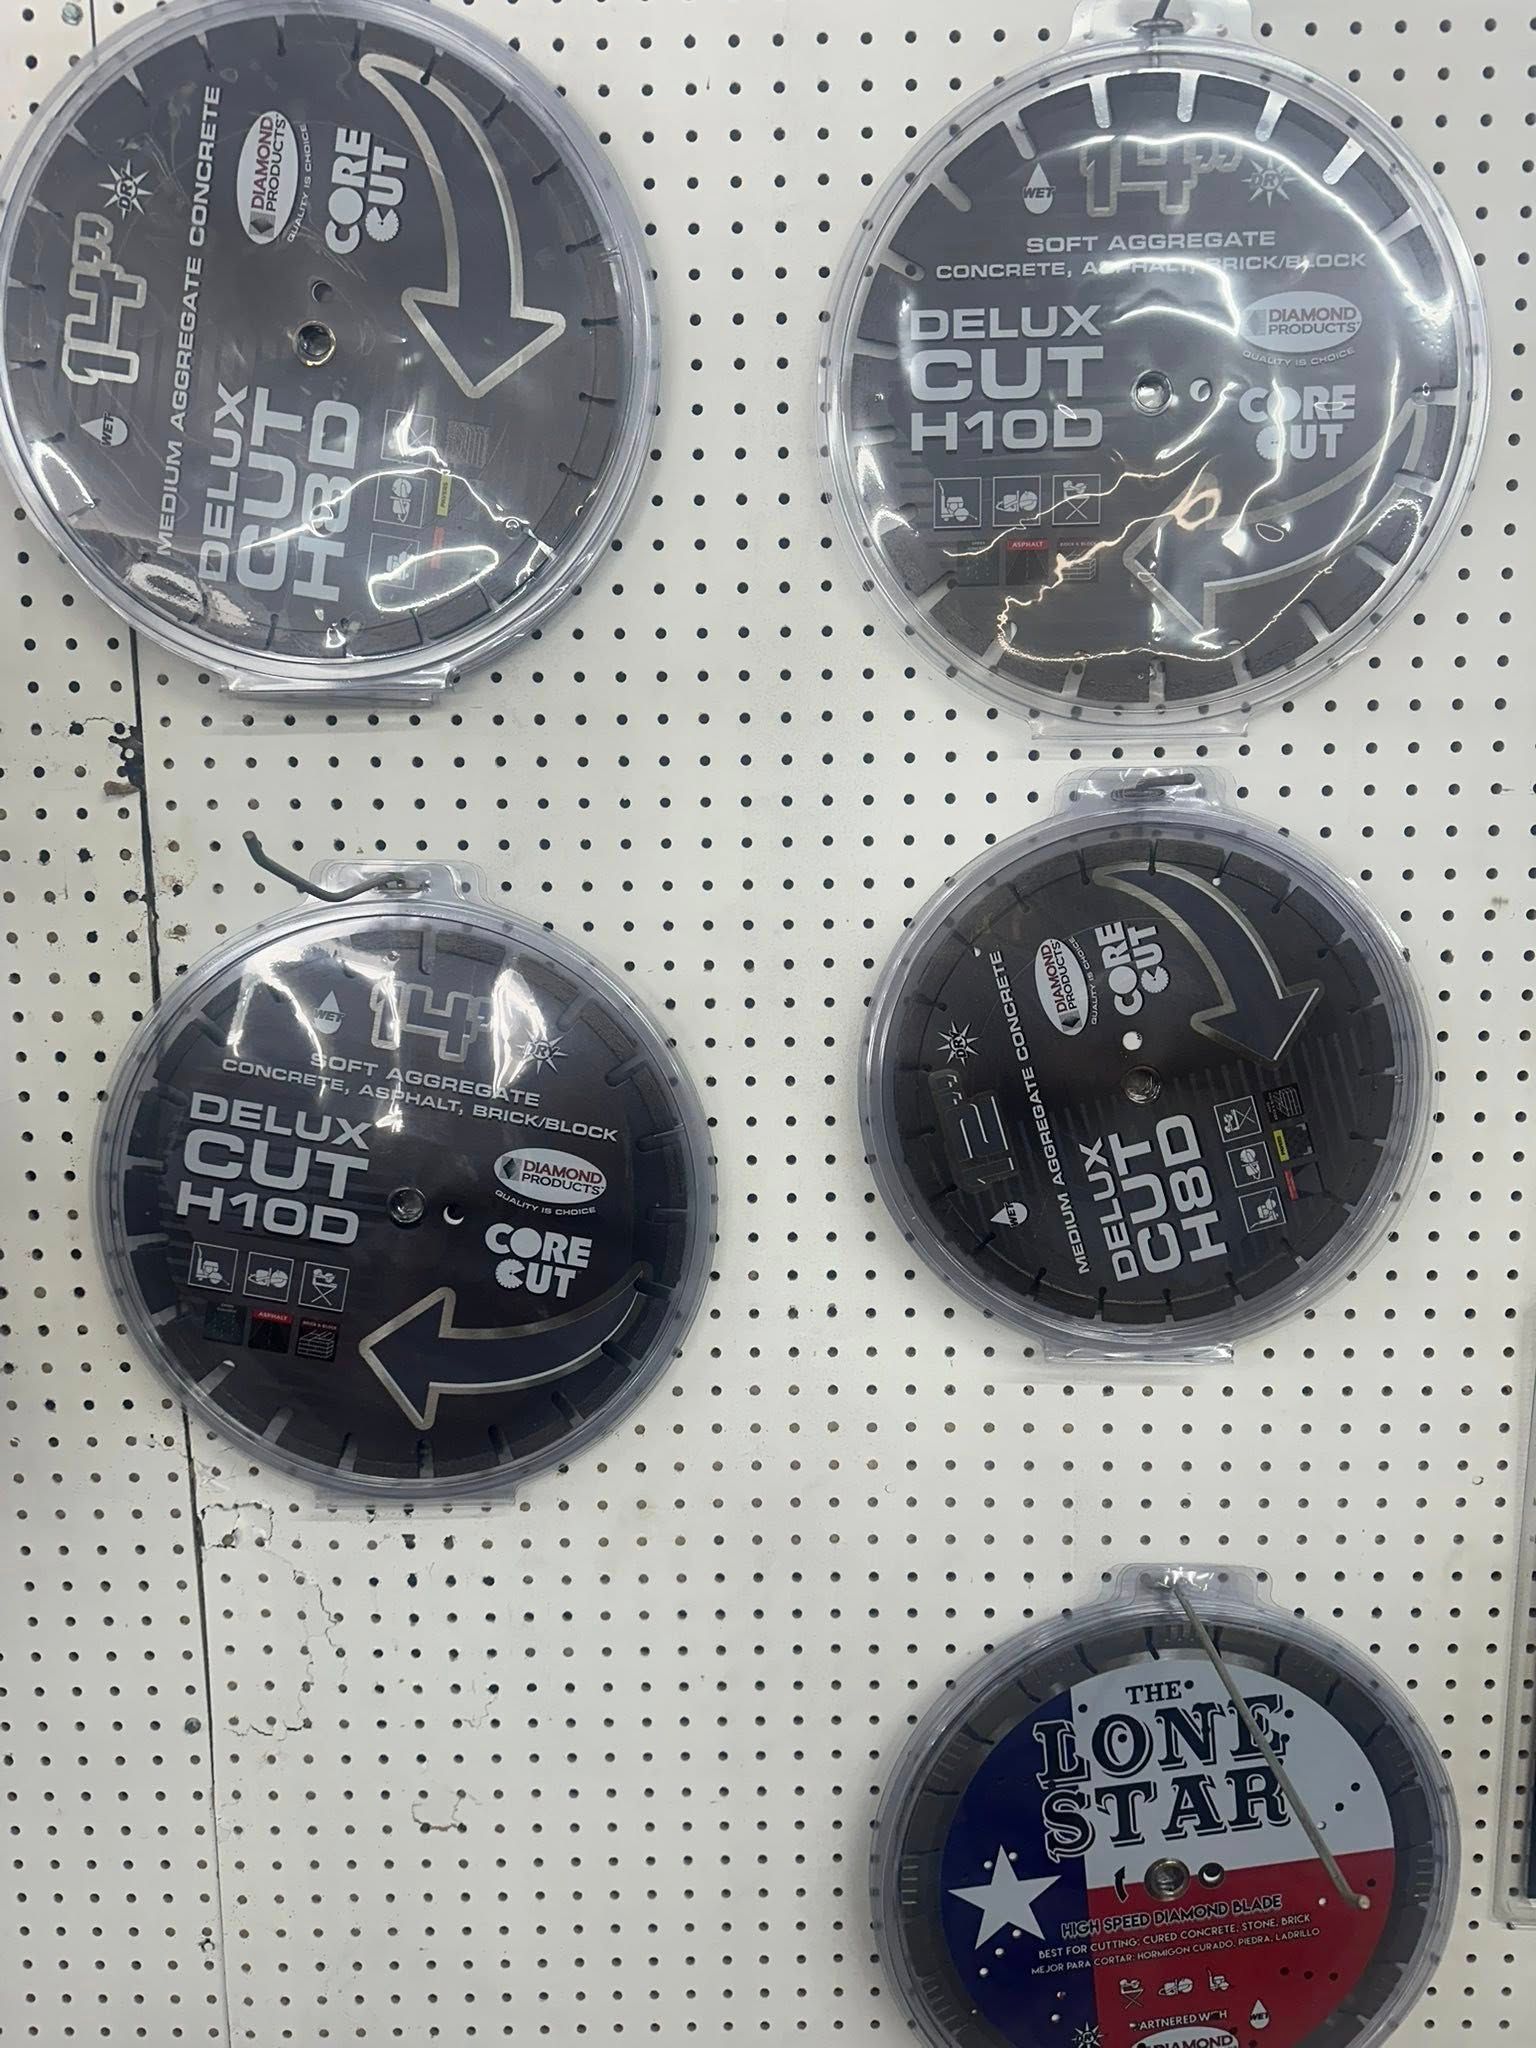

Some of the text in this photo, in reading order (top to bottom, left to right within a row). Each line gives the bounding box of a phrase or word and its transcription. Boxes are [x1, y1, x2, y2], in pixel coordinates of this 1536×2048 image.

[251, 116, 274, 210] DIAMOND
[266, 118, 287, 212] PRODUCTS
[287, 123, 312, 243] QUALITY IS CHOICE
[117, 167, 134, 211] DRY
[325, 127, 371, 254] CORE
[365, 145, 407, 242] CUT
[1023, 187, 1055, 199] WET
[1026, 231, 1276, 253] SOFT AGGREGATE
[936, 253, 1367, 279] CONCRETE, AHALT, BRICK/BLOCK
[157, 86, 220, 556] MEDIUM AGGREGATE CONCRETE
[910, 305, 1102, 341] DELUX
[1268, 307, 1357, 323] DIAMOND
[1268, 322, 1357, 335] PRODUCTS
[910, 346, 1104, 401] CUT
[1242, 347, 1355, 366] QUALITY IS CHOICE
[1239, 384, 1356, 423] CORE
[101, 413, 114, 446] WET
[911, 408, 1103, 452] H10D
[1256, 423, 1344, 460] CUT
[198, 381, 248, 582] DELUX
[236, 386, 303, 591] CUT
[292, 400, 360, 602] H8D
[1052, 941, 1078, 1010] PRODUCTS
[1068, 936, 1090, 970] CHOICE
[1094, 921, 1144, 1016] CORE
[1126, 925, 1170, 994] CUT
[1041, 944, 1068, 1013] DIAMOND
[315, 1009, 345, 1023] WET
[1090, 983, 1098, 1025] QUALITY
[951, 1031, 968, 1059] DRY
[222, 1058, 619, 1142] CONCRETE, ASPHALT, BRICK/BLOCK
[310, 1052, 541, 1107] SOFT AGGREGATE
[190, 1092, 372, 1150] DELUX
[989, 950, 1090, 1275] MEDIUM AGGREGATE CONCRETE
[184, 1128, 370, 1200] CUT
[521, 1172, 601, 1196] PRODUCTS
[523, 1160, 603, 1185] DIAMOND
[495, 1189, 539, 1212] QUALITY
[555, 1206, 597, 1216] CHOICE
[1079, 1137, 1140, 1282] DELUX
[1108, 1133, 1182, 1274] CUT
[1156, 1114, 1228, 1262] H8D
[176, 1181, 360, 1245] H10D
[1004, 1201, 1018, 1229] WET
[485, 1222, 593, 1269] CORE
[495, 1258, 577, 1299] CUT
[259, 1311, 288, 1321] ASPHALT
[1125, 1680, 1182, 1705] THE
[1033, 1694, 1287, 1790] LONE
[1042, 1764, 1291, 1863] STAR
[1038, 1947, 1063, 1960] BEST
[1066, 1944, 1088, 1955] FOR
[1090, 1938, 1140, 1952] CUTTING:
[1143, 1932, 1178, 1944] CURED
[1180, 1924, 1239, 1940] CONCRETE,
[1281, 1913, 1311, 1926] BRICK
[1061, 1893, 1283, 1939] HIGH SPEED DIAMOND BLADE
[1031, 1962, 1064, 1975] MEJOR
[1066, 1960, 1091, 1971] PARA
[1094, 1954, 1135, 1967] CORTAR:
[1137, 1946, 1190, 1960] HORMIGON
[1275, 1927, 1321, 1941] LADRILLO
[1198, 2010, 1228, 2022] WH
[1250, 2012, 1269, 2021] WET
